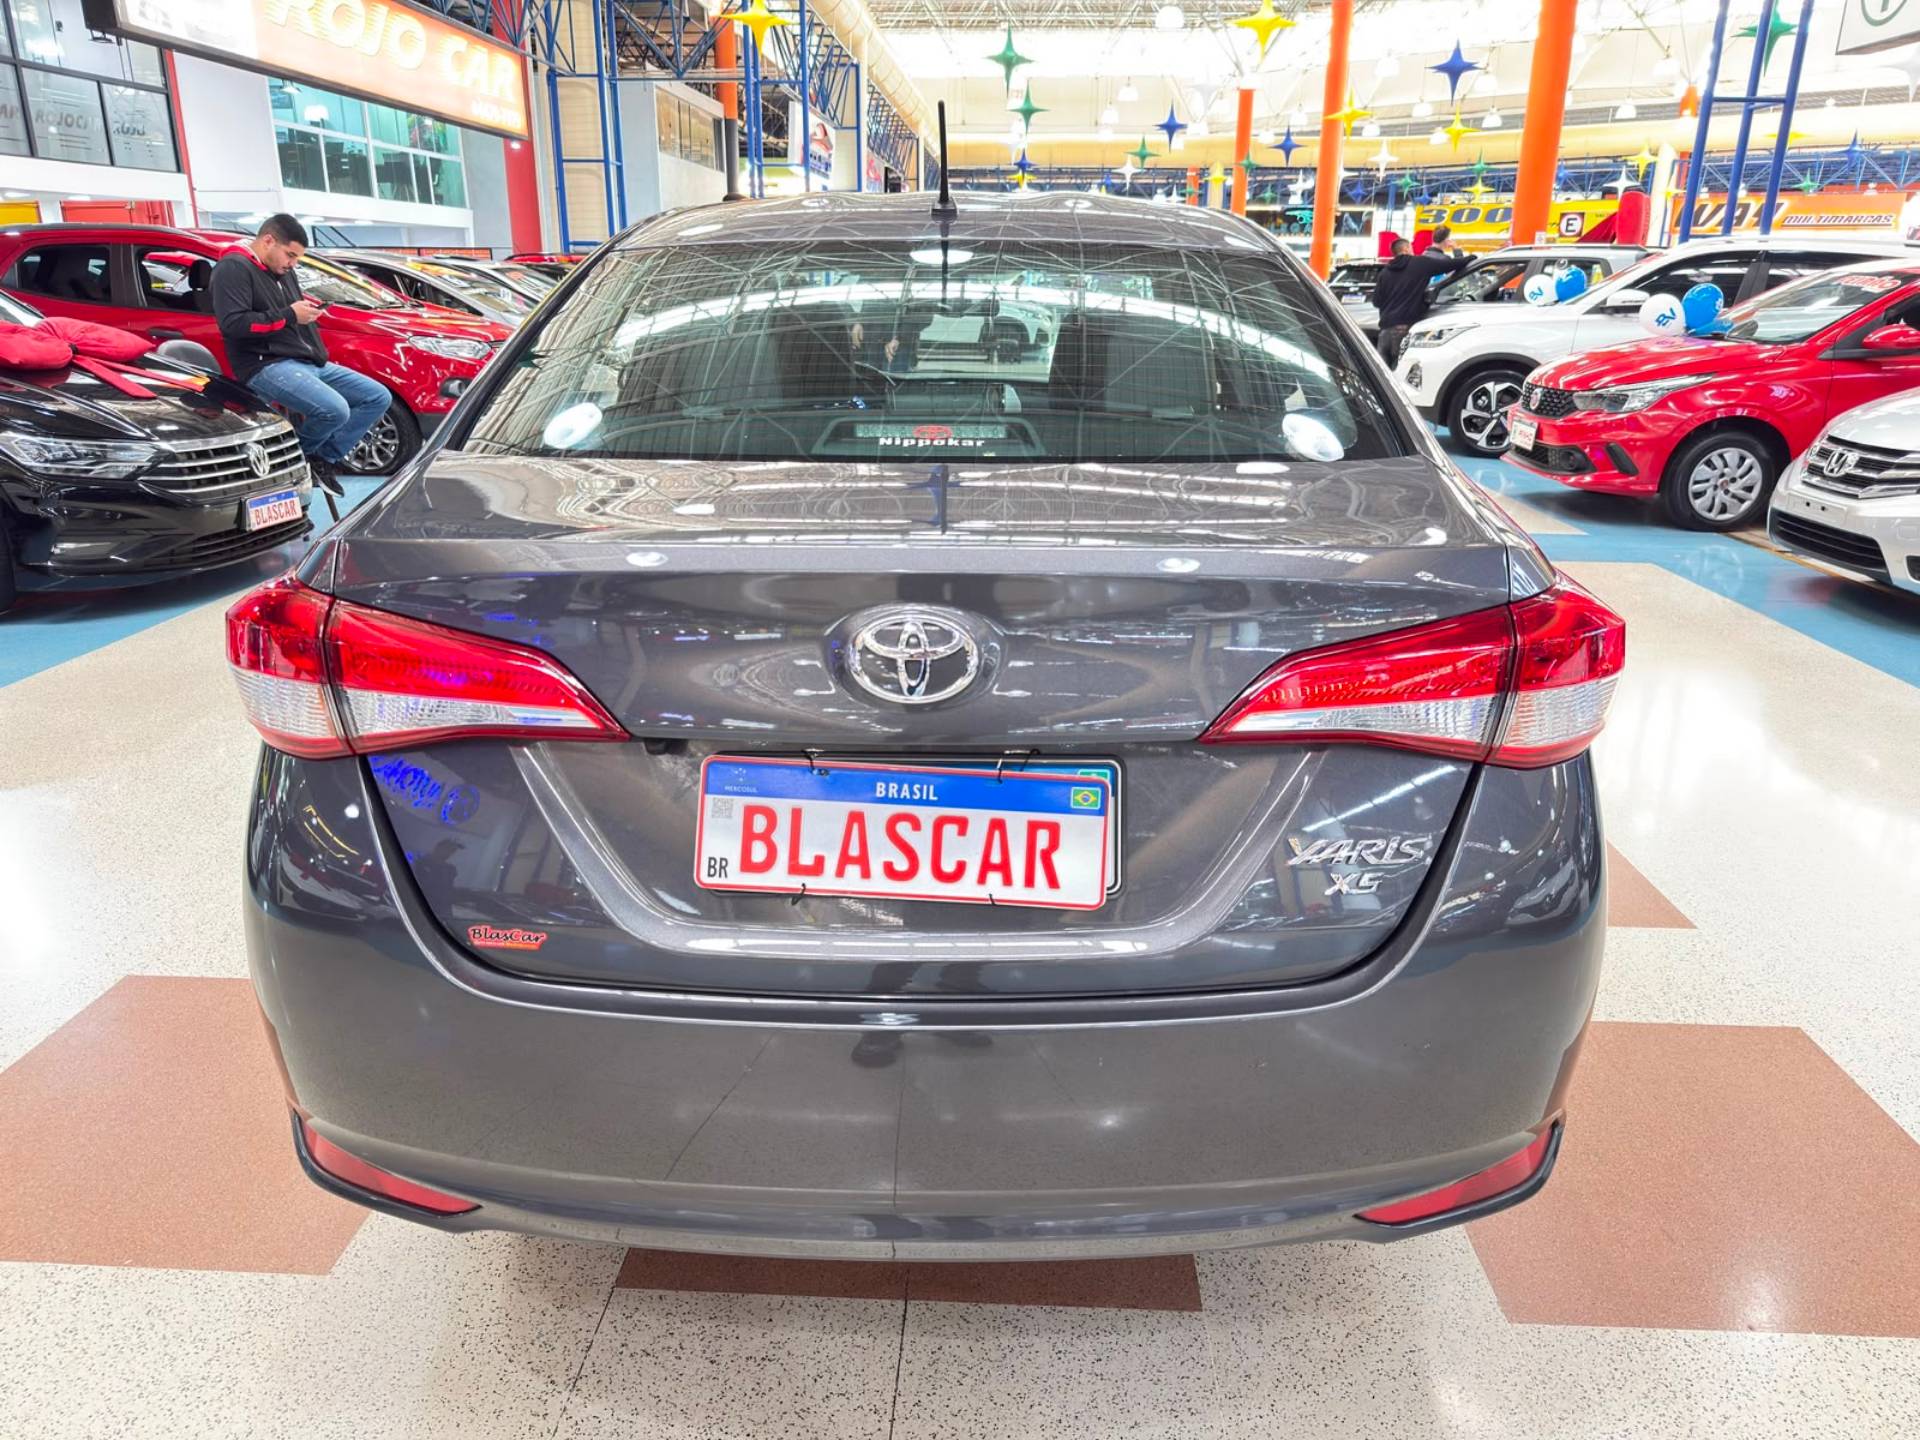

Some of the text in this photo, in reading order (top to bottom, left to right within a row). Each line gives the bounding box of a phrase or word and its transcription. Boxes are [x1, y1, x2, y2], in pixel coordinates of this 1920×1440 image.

[436, 35, 521, 103] CAR
[1564, 217, 1578, 233] E
[1783, 213, 1893, 225] MULTIMARCAS
[878, 437, 986, 447] Nippokar
[255, 500, 297, 525] BLASCAR
[875, 781, 939, 801] BRASIL
[739, 804, 1062, 890] BLASCAR
[1286, 835, 1432, 866] YARIS
[707, 856, 729, 879] BR
[470, 926, 545, 943] BlasCar
